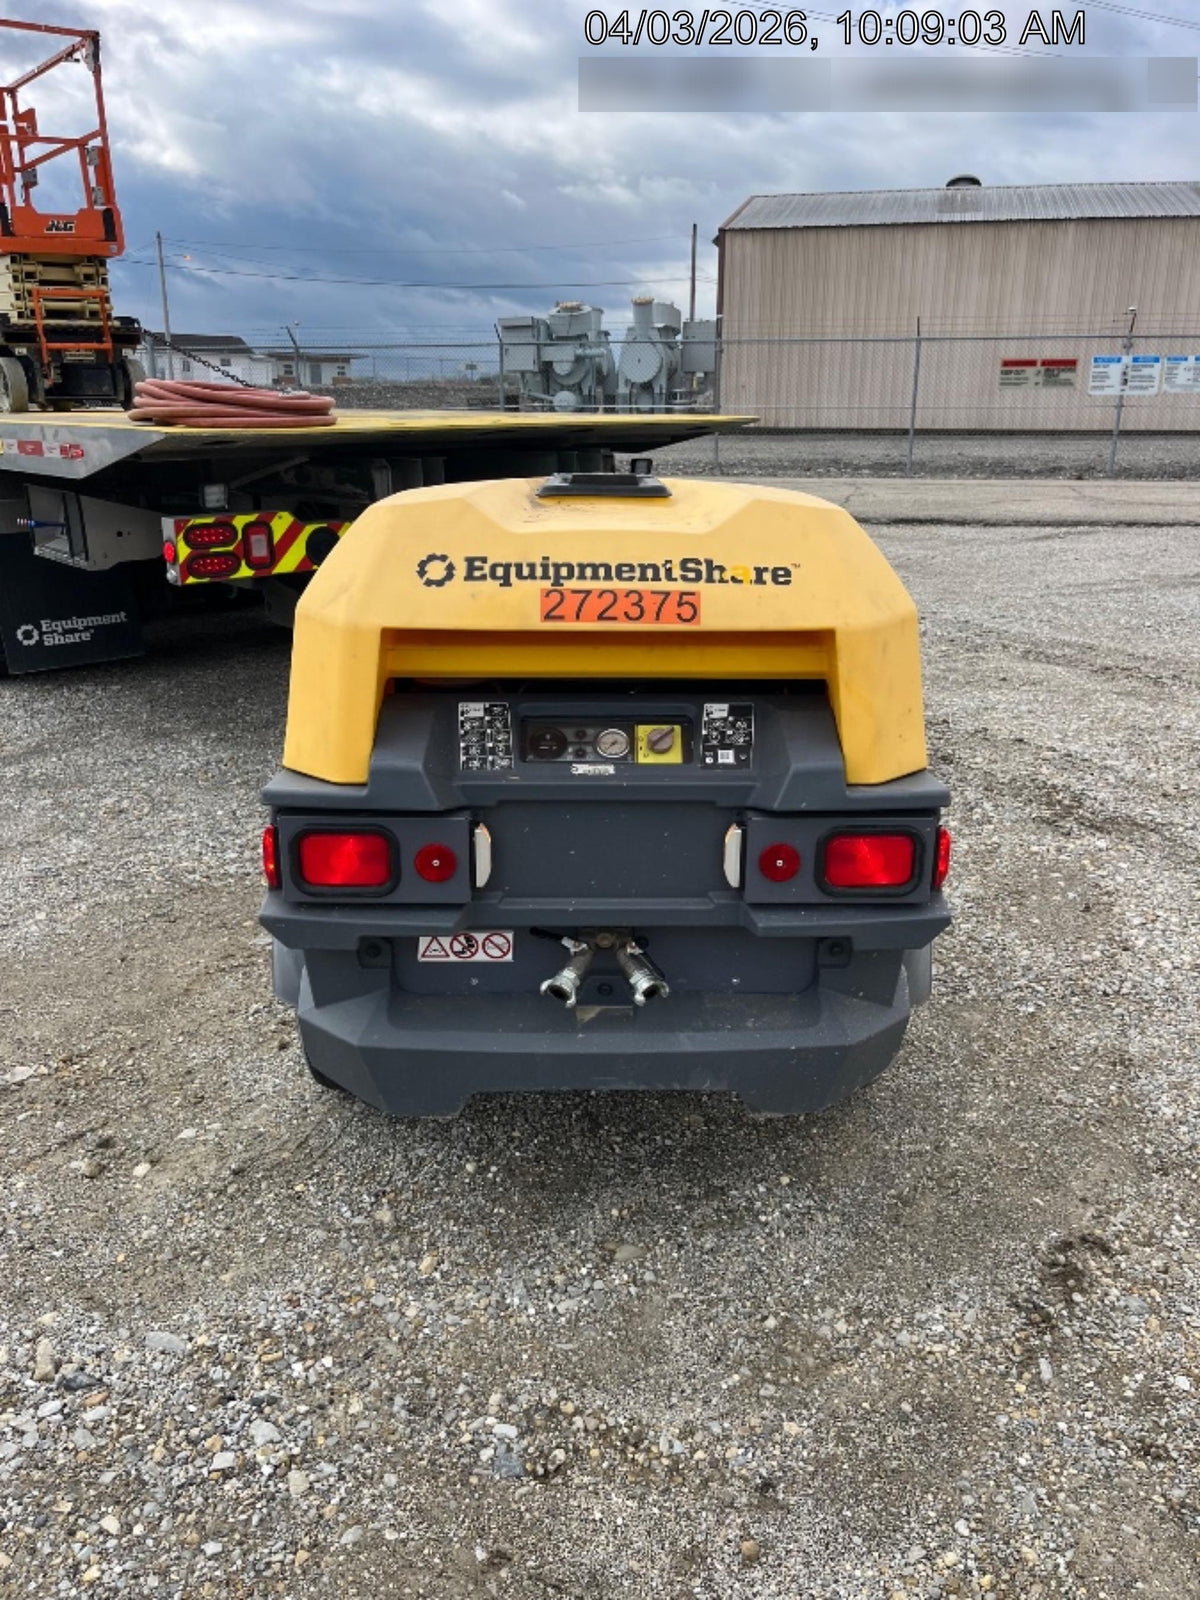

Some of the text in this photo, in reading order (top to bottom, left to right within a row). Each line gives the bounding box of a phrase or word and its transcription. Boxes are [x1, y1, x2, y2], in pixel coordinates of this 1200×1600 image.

[463, 556, 792, 587] EquipmentShare
[542, 589, 698, 623] 272375
[40, 610, 127, 632] Equipment
[43, 630, 92, 646] Share
